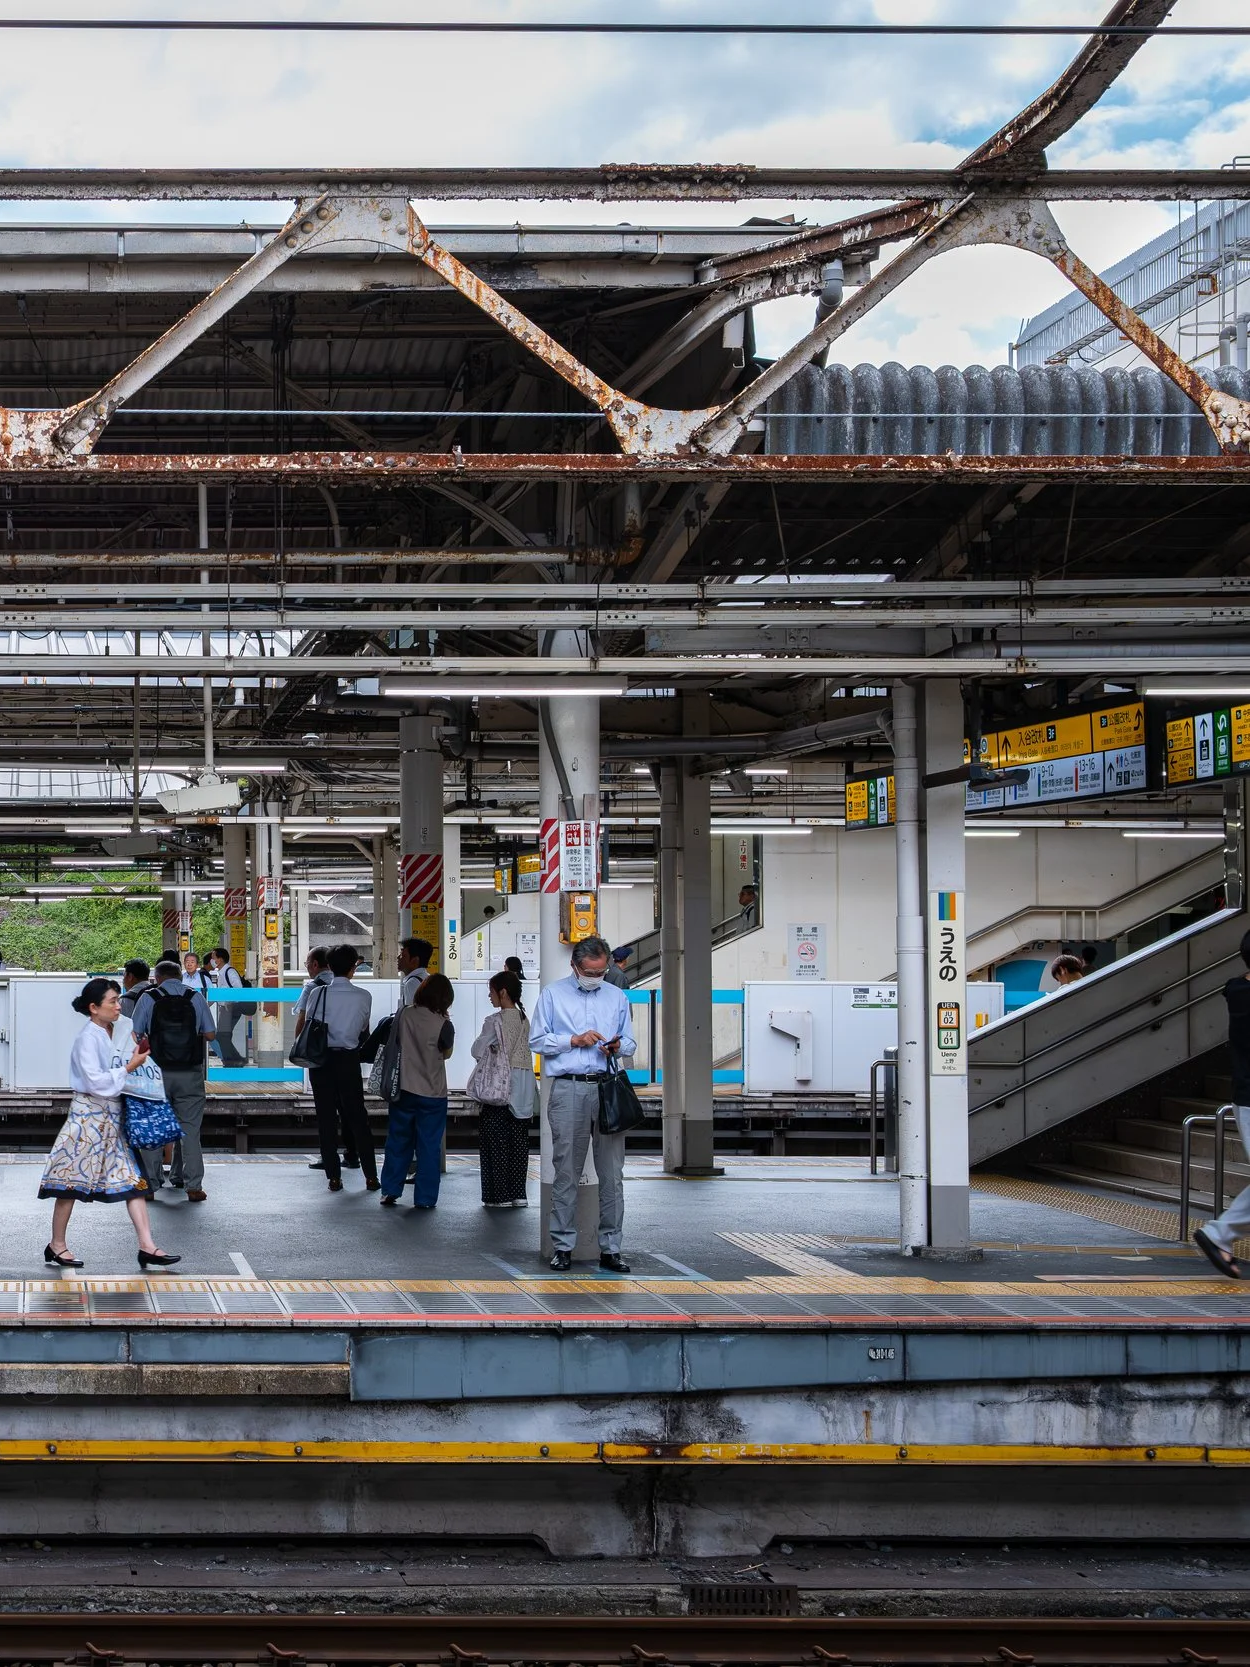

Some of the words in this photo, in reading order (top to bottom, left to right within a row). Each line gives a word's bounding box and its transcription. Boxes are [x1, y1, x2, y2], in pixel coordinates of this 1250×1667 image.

[1108, 711, 1132, 726] 公園改札
[1018, 727, 1046, 747] 入谷改札
[1048, 728, 1055, 740] 3F
[1027, 748, 1039, 758] Gate
[1041, 764, 1054, 778] 9-12
[1078, 757, 1096, 772] 13-16
[739, 839, 747, 870] 上り優先
[448, 876, 456, 884] 18
[448, 935, 458, 960] うえの
[939, 927, 957, 982] うえの
[875, 990, 896, 998] 上野
[943, 1016, 954, 1025] 02
[943, 1037, 954, 1045] 01
